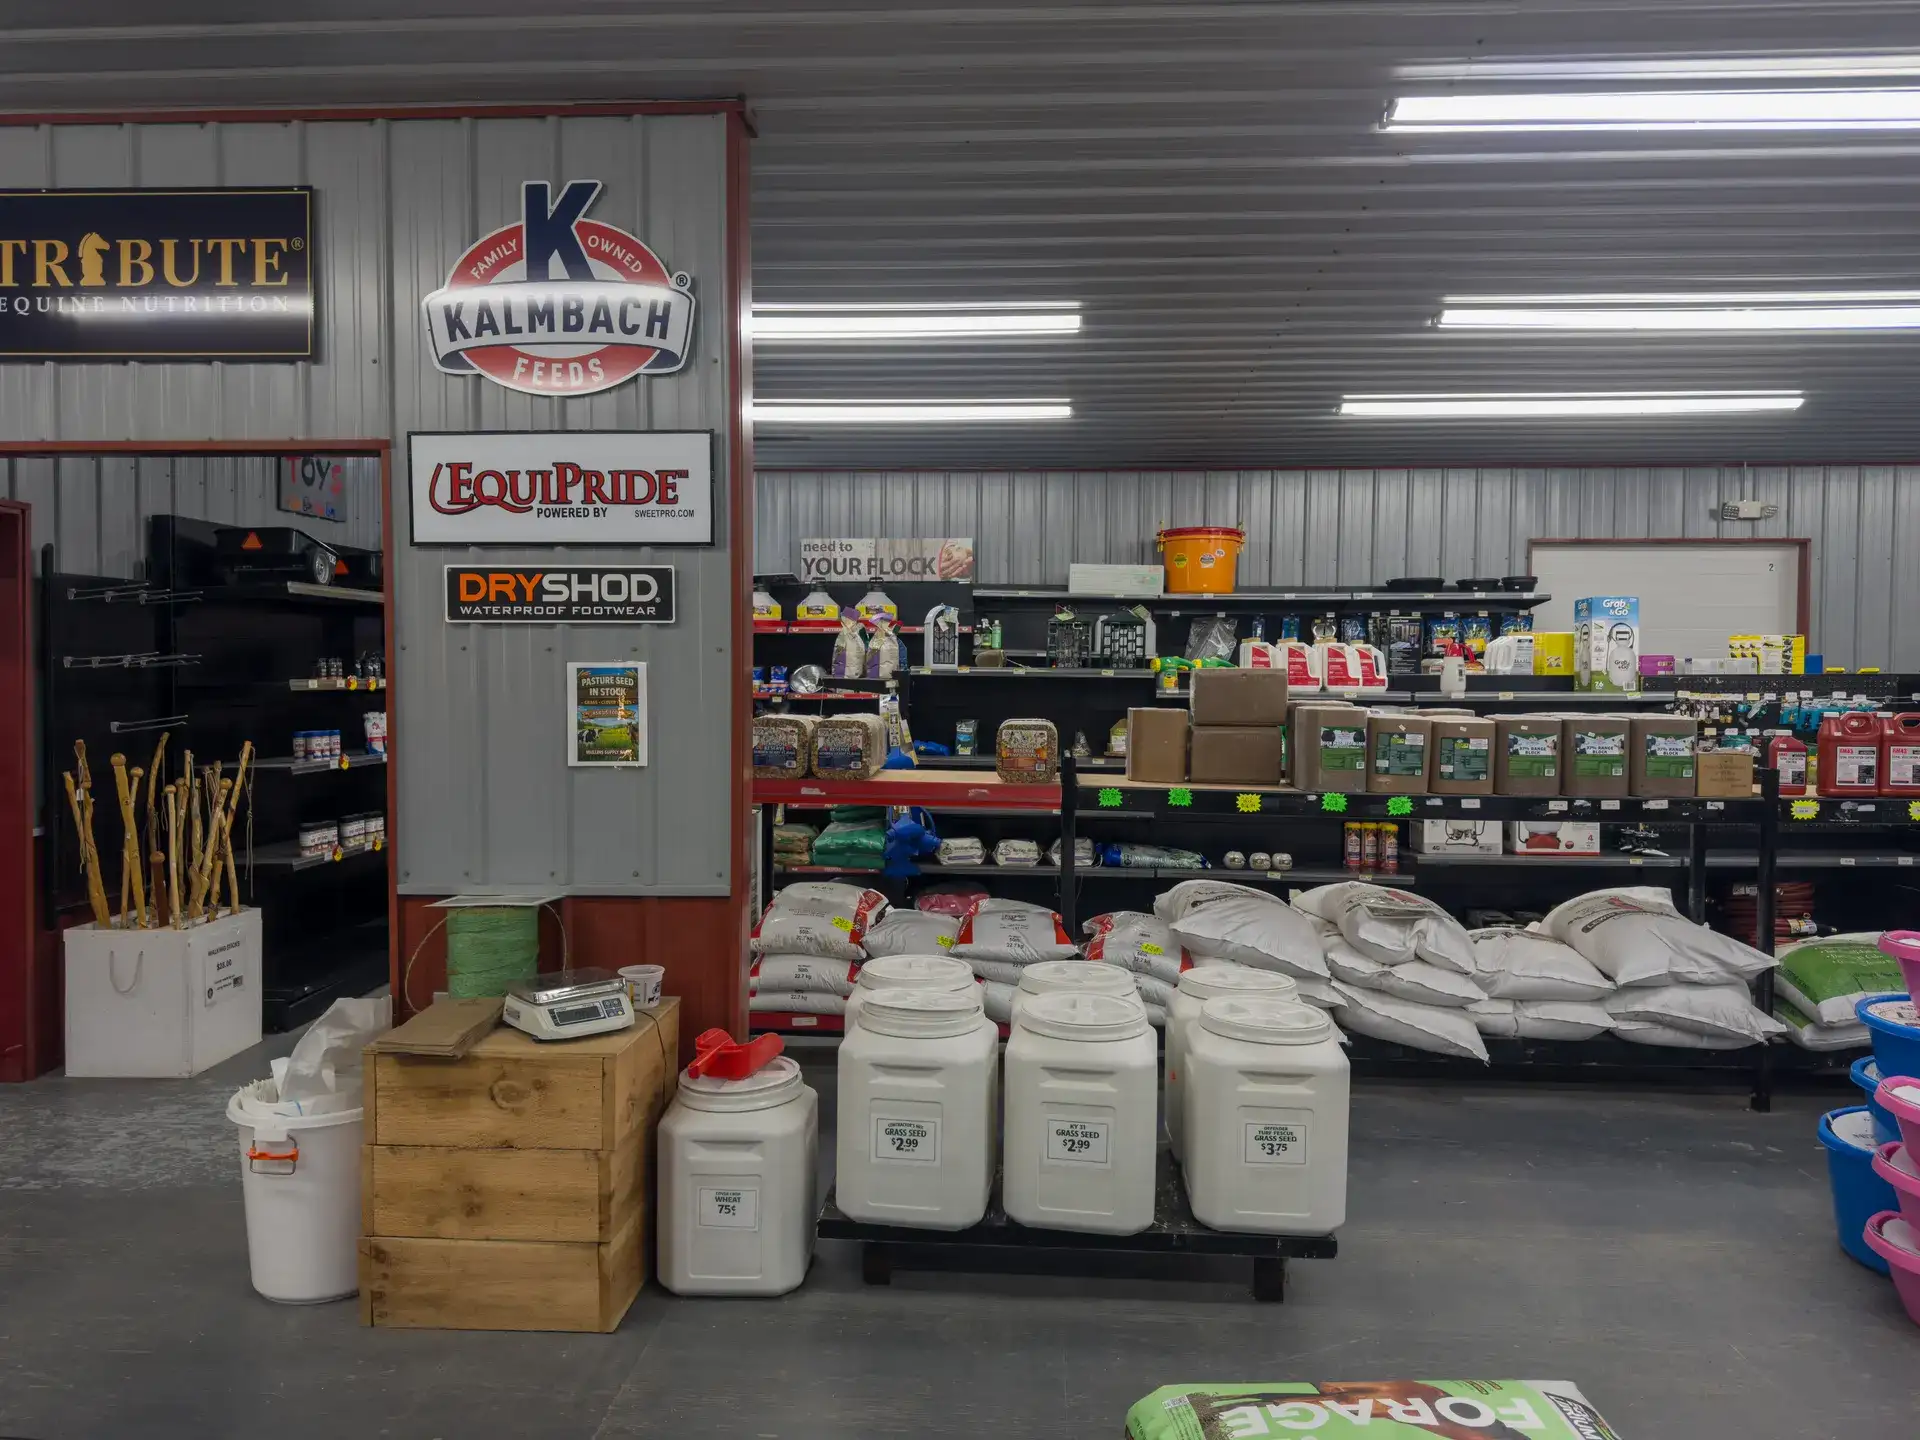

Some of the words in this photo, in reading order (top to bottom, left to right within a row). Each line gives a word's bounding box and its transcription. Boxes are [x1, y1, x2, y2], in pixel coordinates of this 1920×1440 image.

[525, 182, 599, 281] K
[471, 238, 518, 279] FAMILY
[588, 235, 642, 274] OWNED
[0, 297, 105, 315] EQUINE
[121, 296, 289, 312] NUTRITION
[443, 294, 672, 342] KALMBACH
[512, 357, 605, 388] FEEDS
[537, 507, 590, 518] POWERED
[594, 507, 608, 518] BY
[634, 509, 695, 518] SWEETPRO.COM
[803, 540, 836, 552] need
[839, 542, 852, 552] to
[802, 557, 862, 575] YOUR
[867, 556, 936, 575] FLOCK
[1768, 563, 1774, 572] 2
[459, 573, 658, 602] DRYSHOD
[1602, 598, 1626, 608] Grab
[460, 606, 566, 615] WATERPROOF
[572, 606, 656, 615] FOOTWEAR
[582, 676, 614, 686] PASTURE
[615, 677, 634, 686] SEED
[590, 688, 599, 696] IN
[600, 687, 626, 696] STOCK
[885, 1128, 907, 1136] GRASS
[1056, 1129, 1079, 1137] GRASS
[891, 1138, 918, 1151] $2.99
[1062, 1139, 1090, 1152] $2.99
[1261, 1143, 1288, 1155] $3.75
[1221, 1397, 1546, 1439] FORAGE
